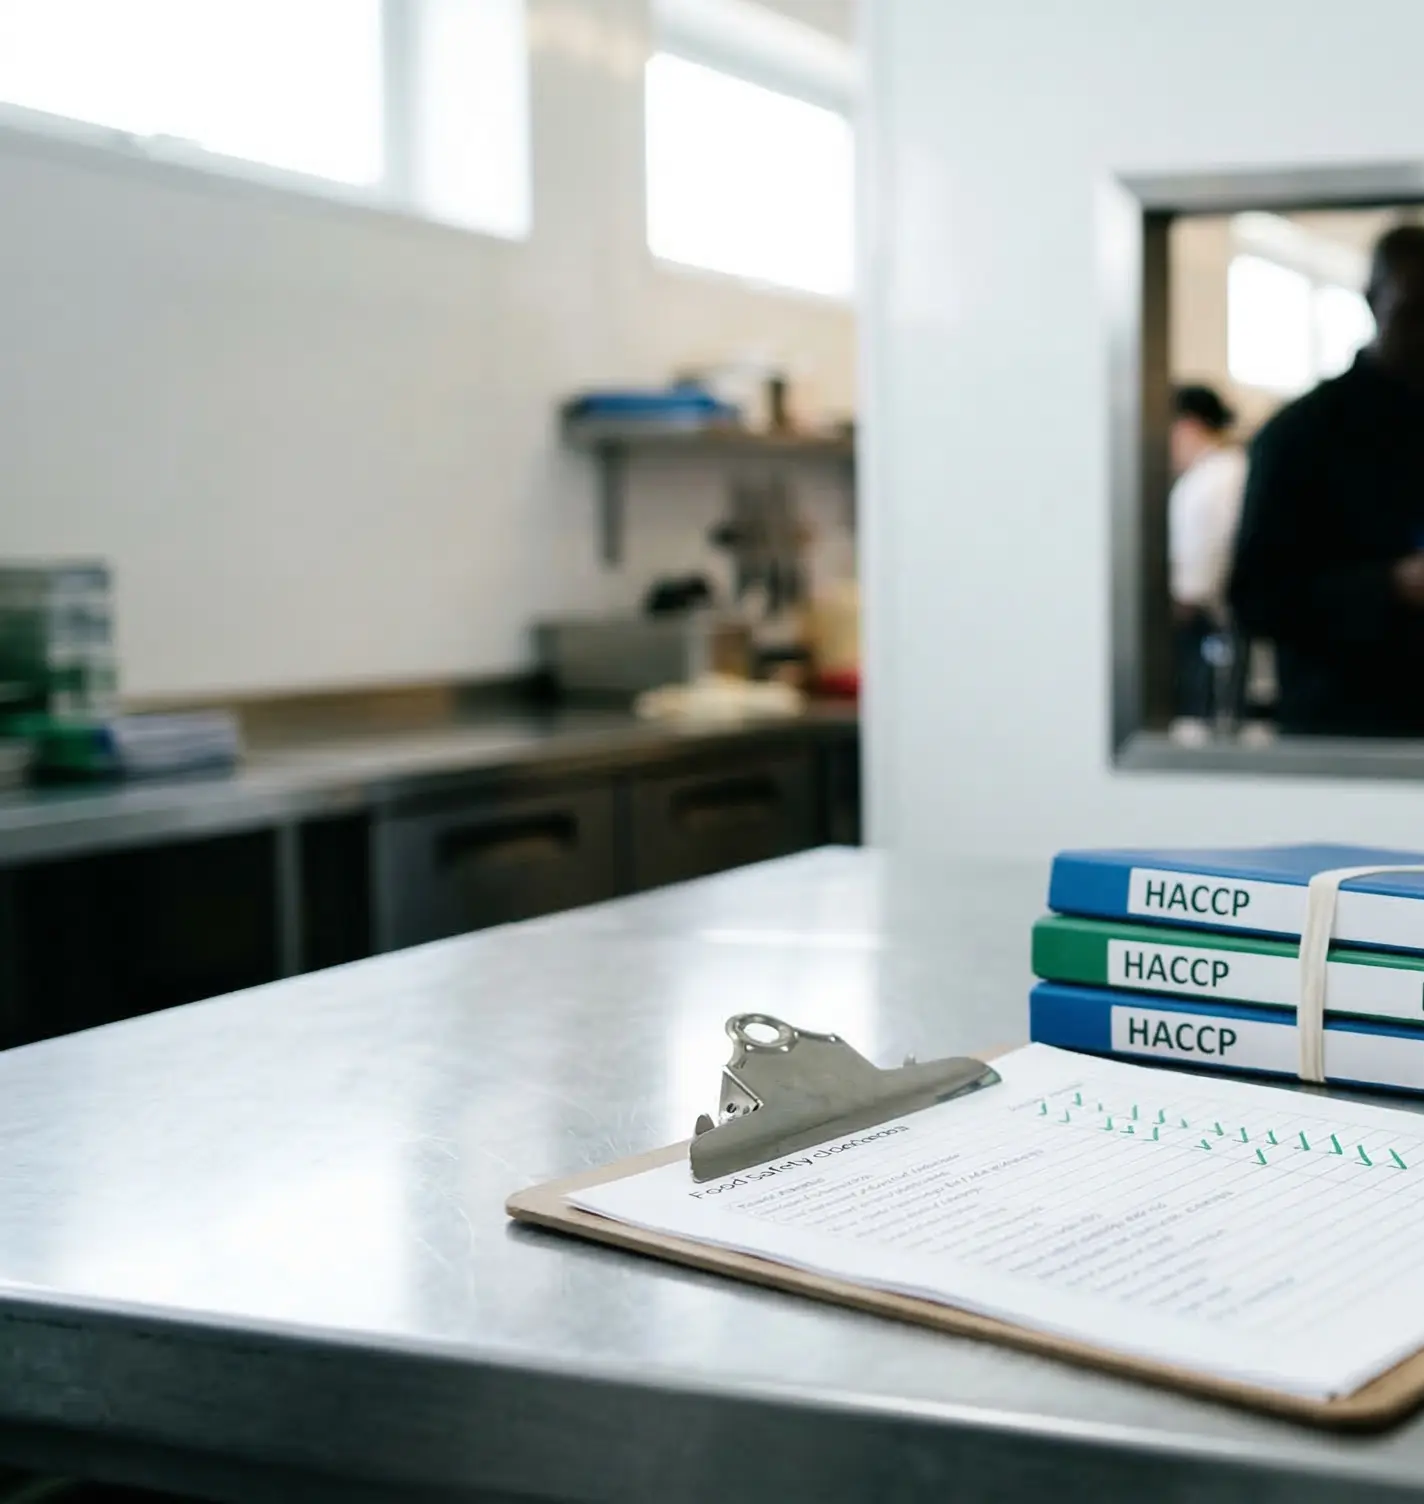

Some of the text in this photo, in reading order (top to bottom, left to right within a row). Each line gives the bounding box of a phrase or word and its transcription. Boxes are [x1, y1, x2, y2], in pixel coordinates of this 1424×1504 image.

[1145, 880, 1250, 917] HACCP
[1124, 950, 1230, 988] HACCP
[1128, 1017, 1237, 1056] HACCP
[689, 1178, 748, 1199] Food
